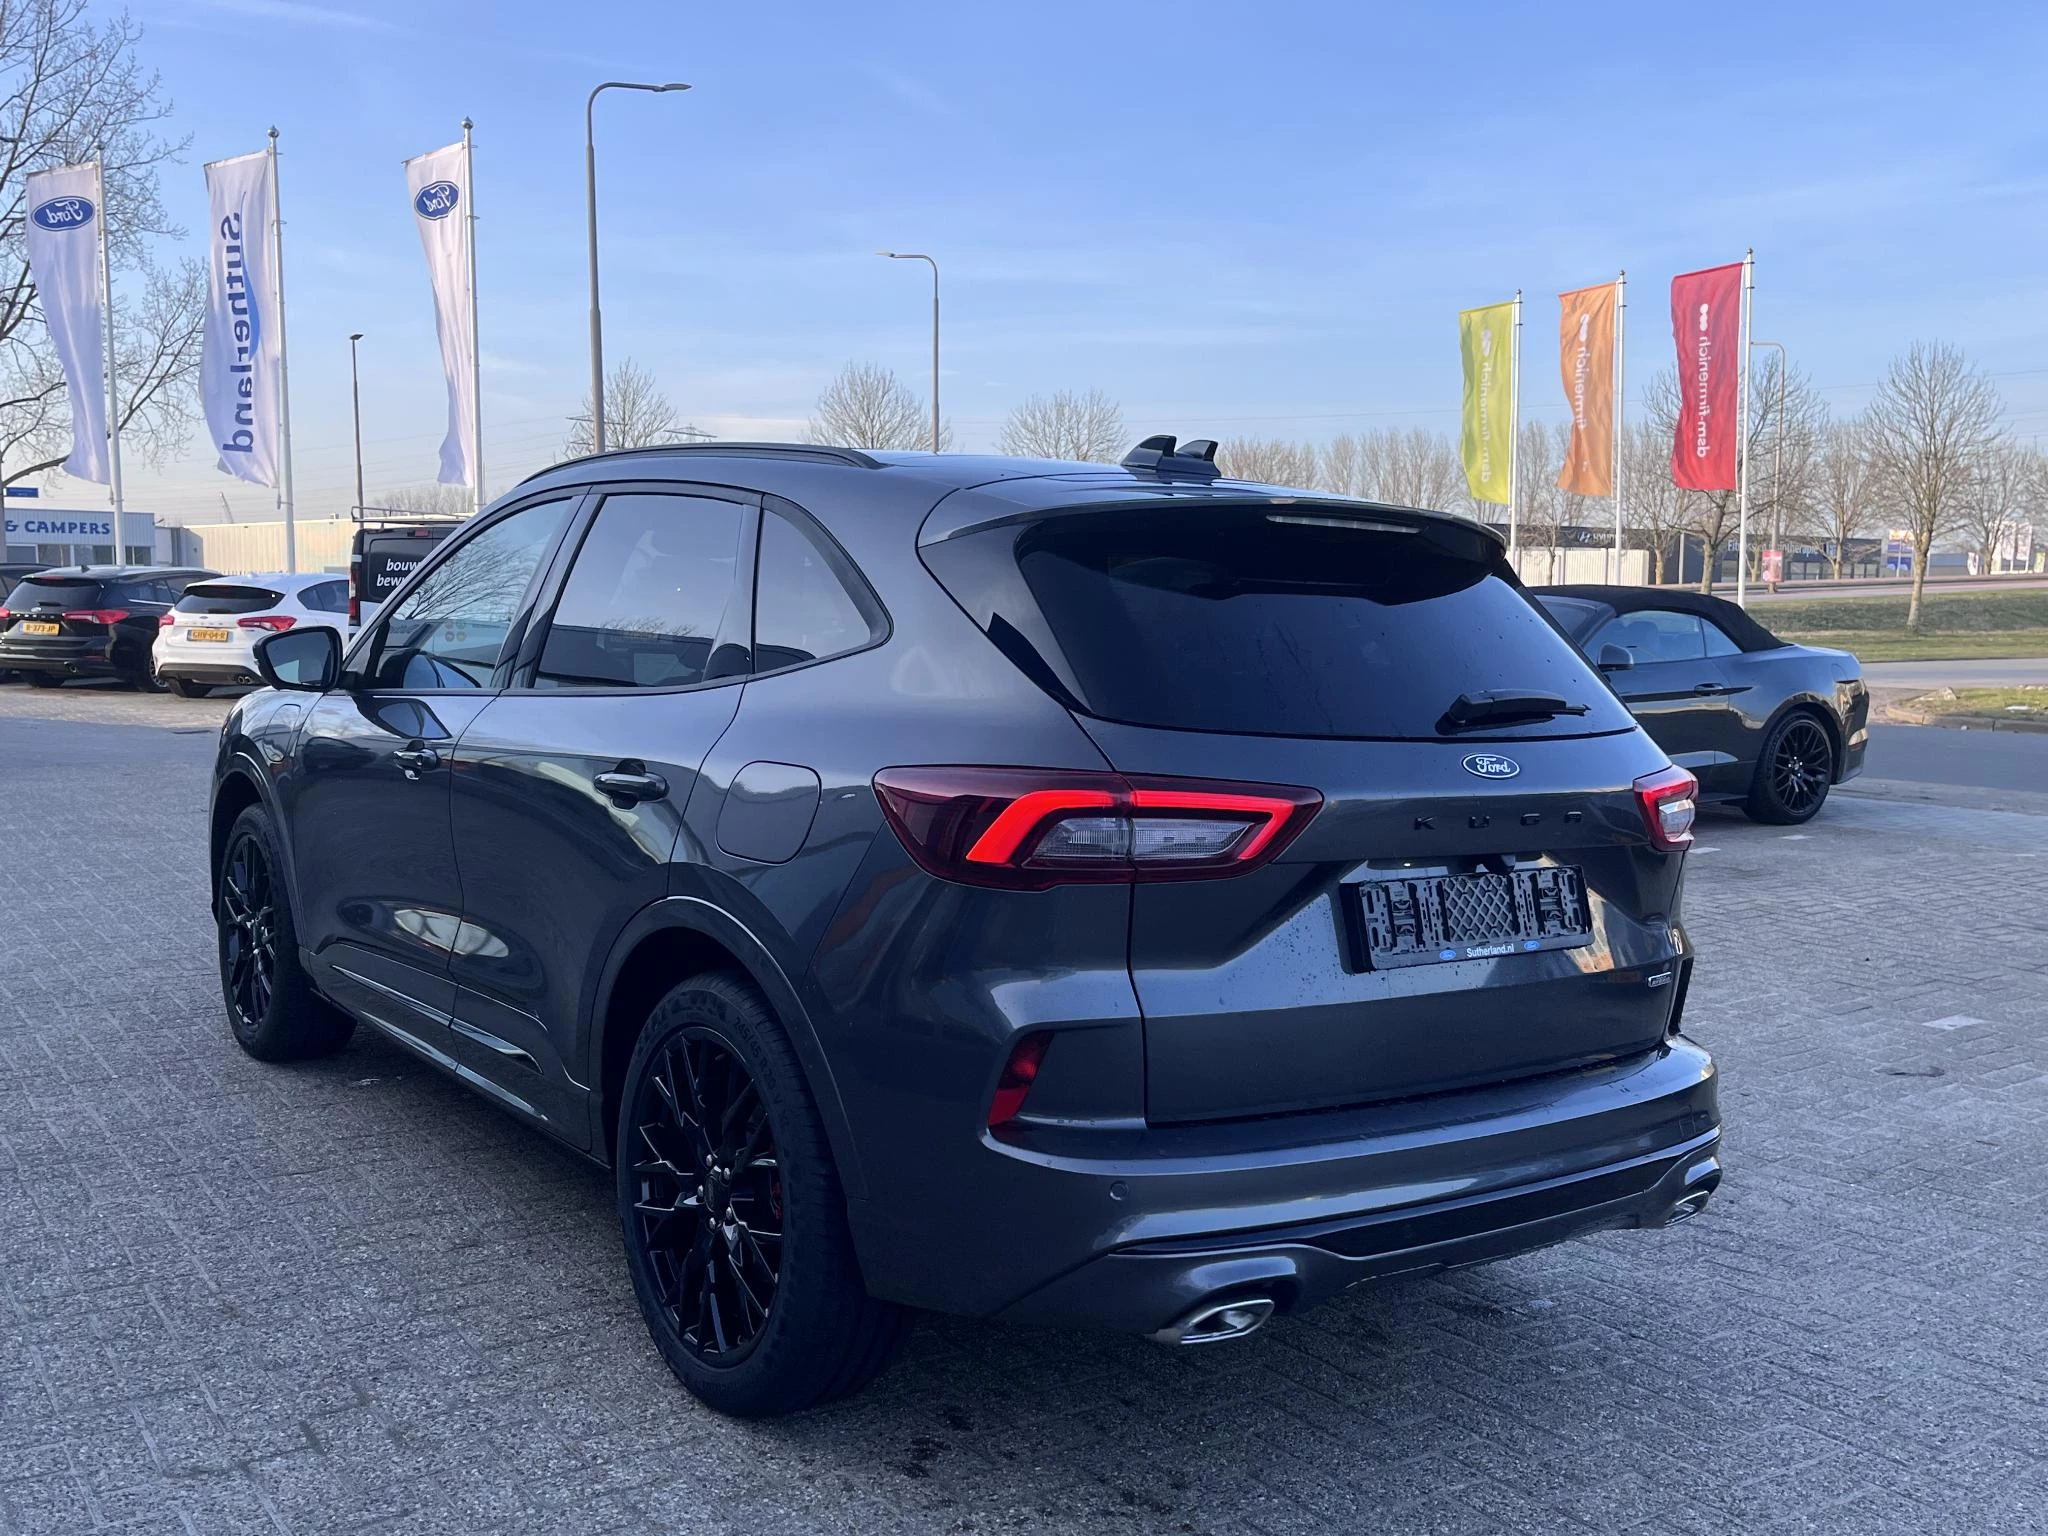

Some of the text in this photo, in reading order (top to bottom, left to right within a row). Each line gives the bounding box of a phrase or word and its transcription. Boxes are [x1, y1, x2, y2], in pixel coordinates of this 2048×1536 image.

[4, 520, 111, 535] & CAMPERS
[1466, 943, 1515, 958] Sutherland.nl
